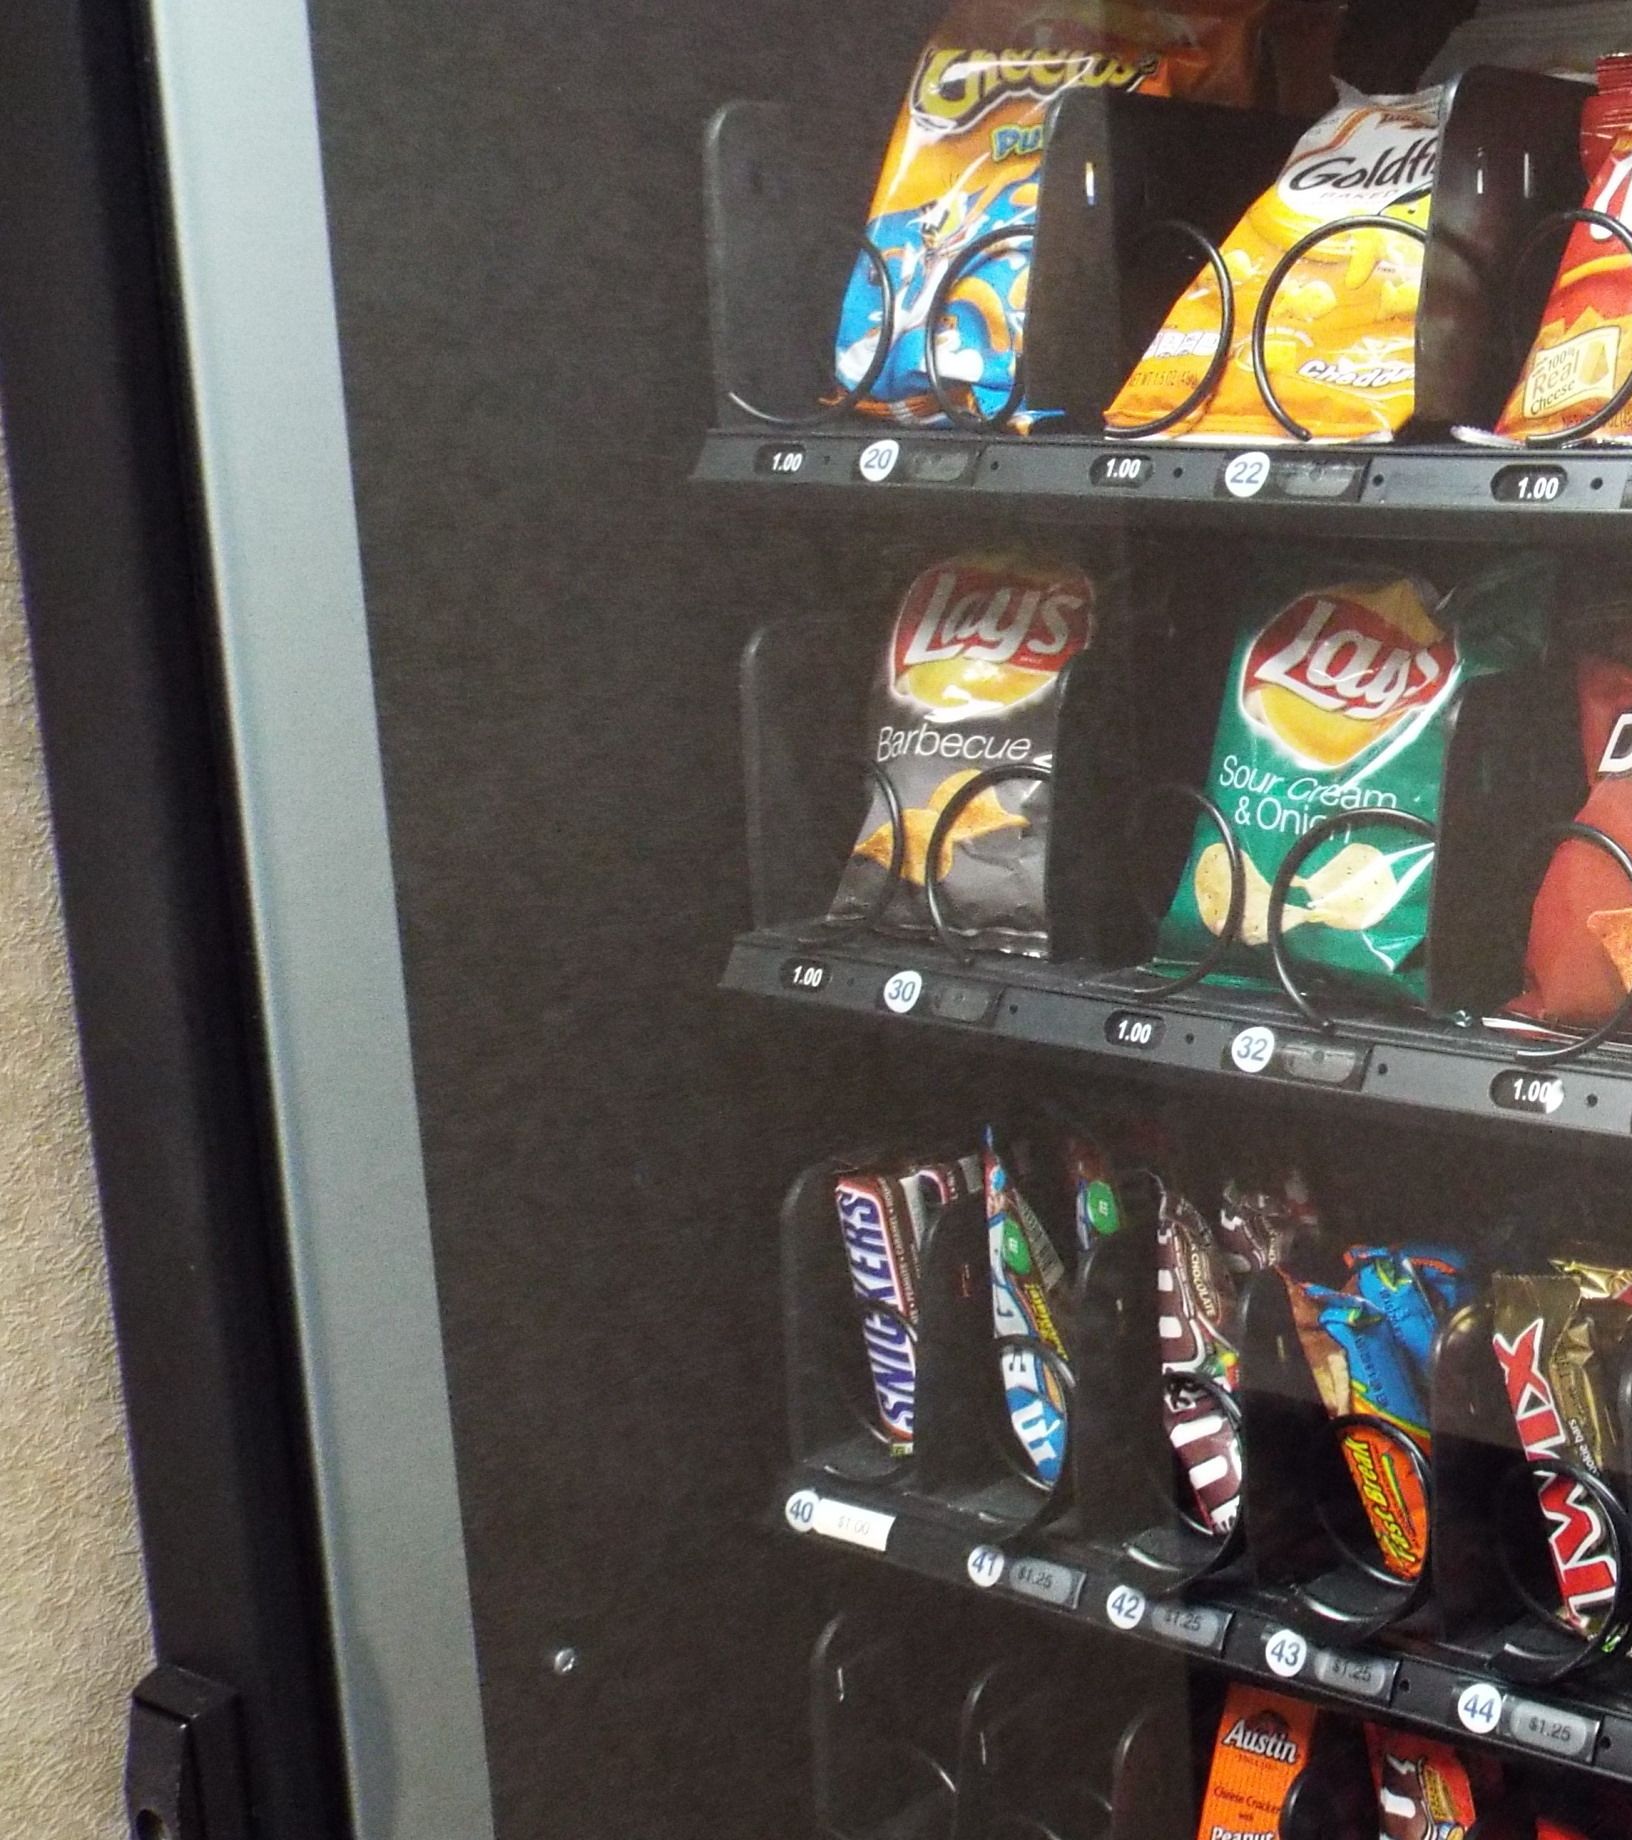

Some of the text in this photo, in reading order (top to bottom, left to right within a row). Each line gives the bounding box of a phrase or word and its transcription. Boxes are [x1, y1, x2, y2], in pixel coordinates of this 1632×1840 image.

[1532, 350, 1581, 400] Real
[772, 453, 802, 472] 1.00
[863, 447, 892, 472] 20
[1106, 458, 1141, 479] 1.00
[1230, 462, 1263, 484] 22
[1516, 477, 1559, 500] 1.00
[877, 723, 1031, 763] Barbecue
[1220, 755, 1397, 810] Sour Cream
[1235, 796, 1251, 826] &
[792, 965, 823, 988] 1.00
[889, 978, 916, 1002] 30
[1117, 1022, 1151, 1044] 1.00
[1237, 1037, 1269, 1061] 32
[838, 1188, 915, 1434] SNICKERS
[1343, 1435, 1389, 1507] Break
[1492, 1318, 1617, 1630] TWIX
[789, 1499, 814, 1523] 40
[1373, 1506, 1417, 1564] Fast
[972, 1552, 996, 1577] 41
[1018, 1566, 1053, 1589] $1.25
[1111, 1593, 1138, 1620] 42
[1271, 1640, 1299, 1668] 43
[1333, 1660, 1372, 1683] $1.25
[1463, 1694, 1493, 1723] 44
[1224, 1719, 1298, 1763] Austin
[1529, 1715, 1571, 1742] $1.25
[1212, 1826, 1274, 1840] Peanut
